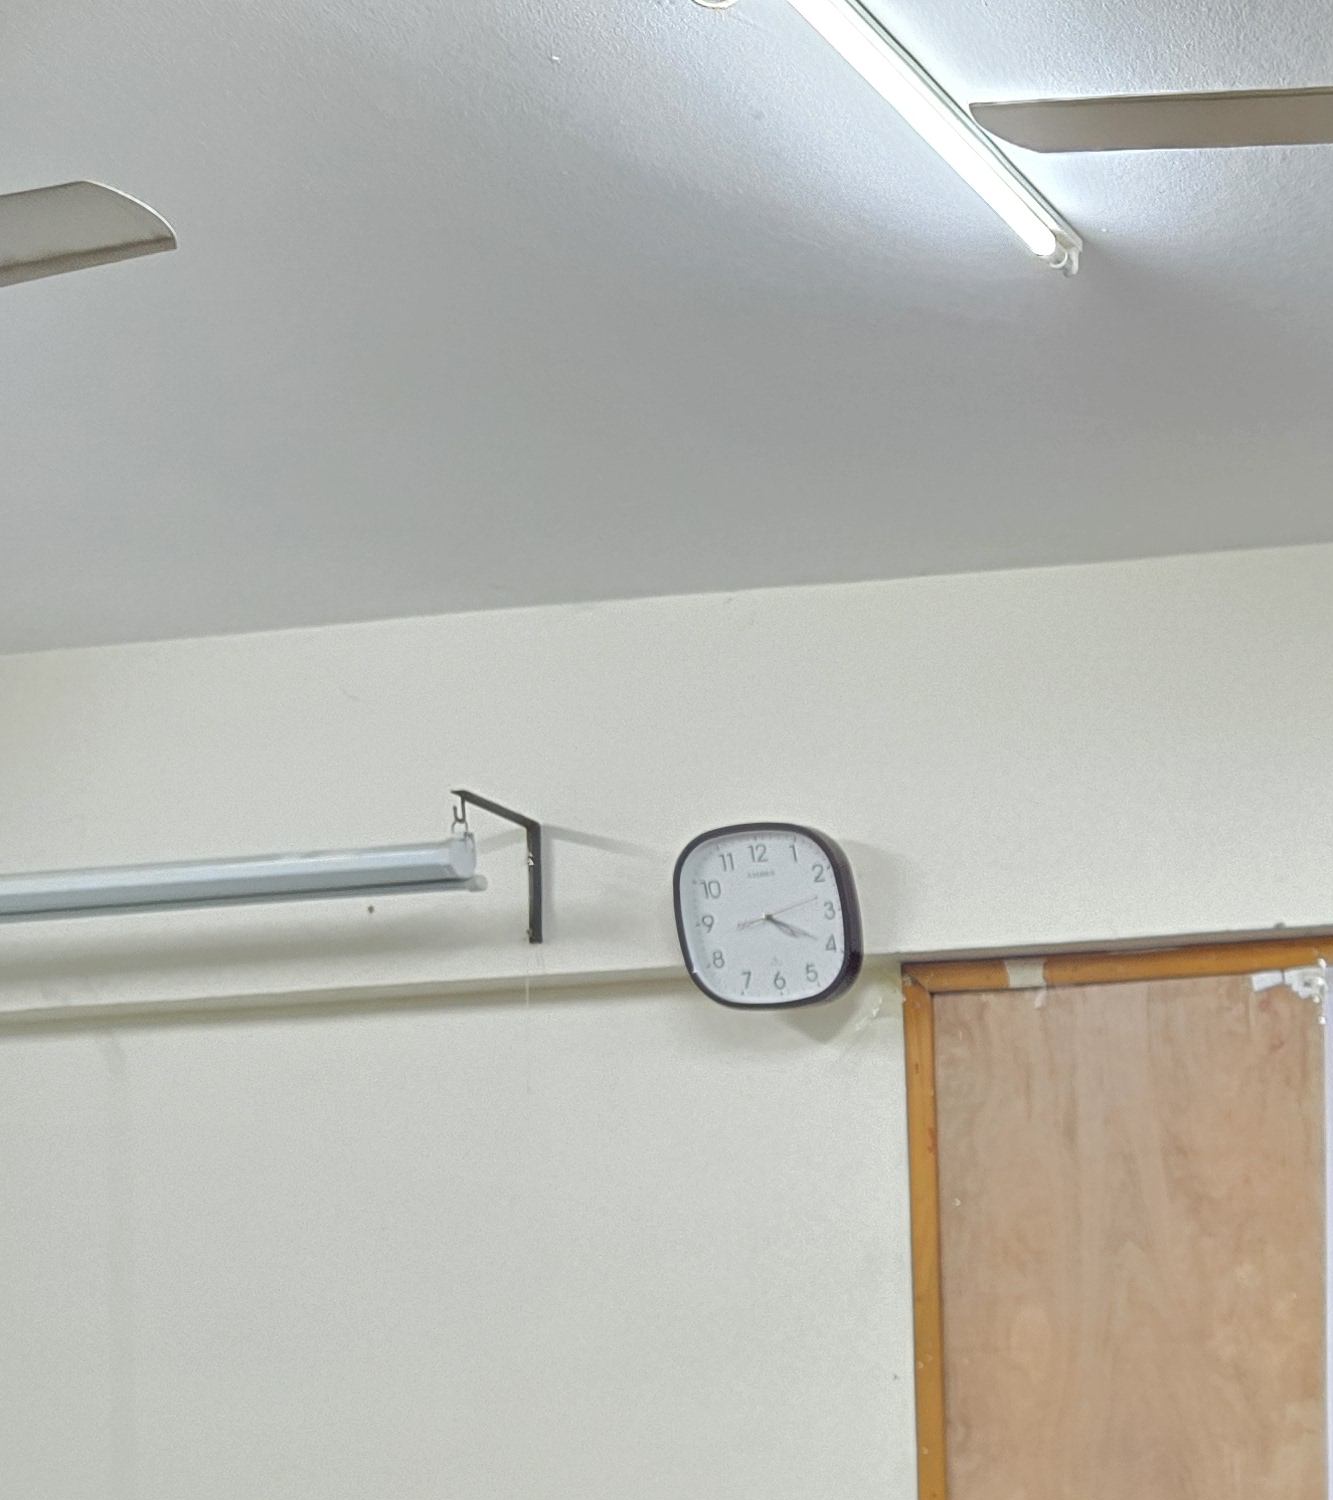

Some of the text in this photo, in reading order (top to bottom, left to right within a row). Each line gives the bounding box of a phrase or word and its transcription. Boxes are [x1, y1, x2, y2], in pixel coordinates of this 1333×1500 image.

[719, 852, 735, 872] 11
[747, 844, 769, 863] 12
[788, 844, 797, 862] 1
[811, 864, 826, 883] 2
[700, 880, 721, 899] 10
[823, 901, 836, 920] 3
[701, 914, 715, 934] 9
[825, 935, 837, 953] 4
[712, 950, 725, 969] 8
[741, 971, 752, 990] 7
[774, 971, 786, 990] 6
[805, 964, 818, 983] 5
